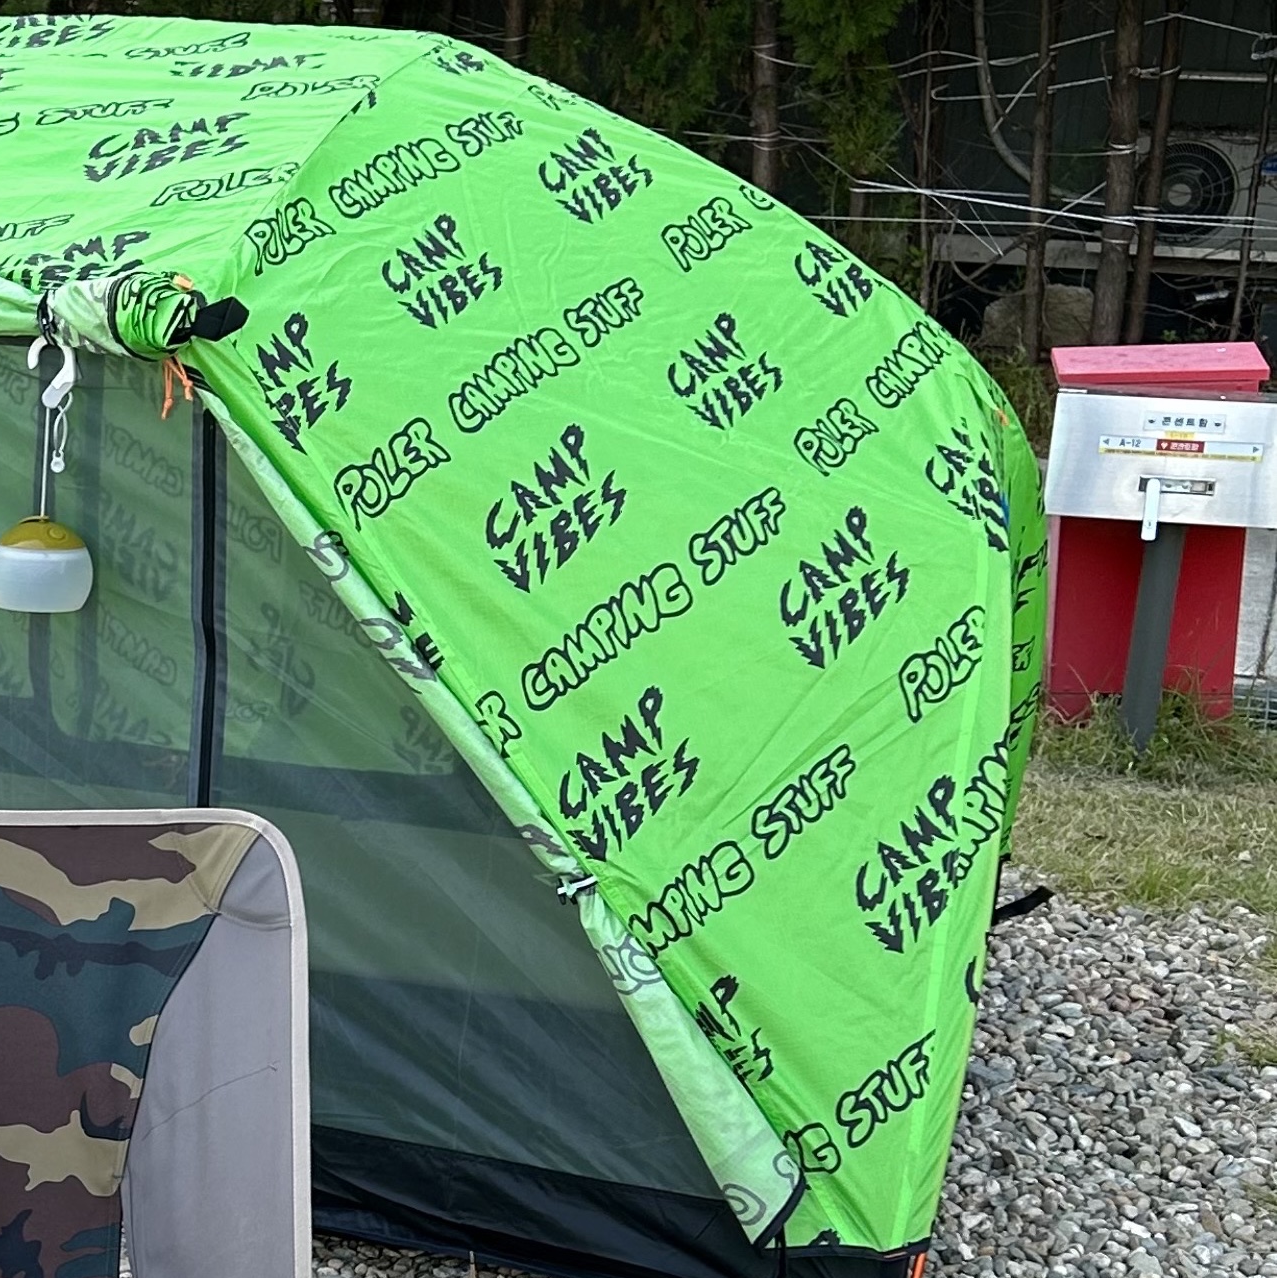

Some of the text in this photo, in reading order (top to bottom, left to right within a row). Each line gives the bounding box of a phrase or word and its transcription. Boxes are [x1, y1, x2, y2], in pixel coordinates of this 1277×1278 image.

[36, 98, 175, 126] STUFF
[88, 112, 251, 160] CAMP
[83, 133, 250, 182] VIBES
[149, 162, 300, 207] POLER
[538, 127, 615, 193] CAMP
[555, 154, 653, 224] VIBES
[244, 198, 337, 275] POLER
[328, 138, 461, 218] CAMPING
[661, 197, 753, 272] POLER
[382, 214, 466, 294] CAMP
[398, 252, 503, 329] VIBES
[667, 313, 746, 399] CAMP
[685, 351, 783, 430] VIBES
[334, 277, 644, 532] POLER CAMPING STUFF
[794, 398, 880, 477] POLER
[486, 423, 592, 550] CAMP
[494, 469, 628, 594] VIBES
[780, 505, 874, 627] CAMP
[523, 562, 694, 711] CAMPING
[689, 486, 787, 587] STUFF
[788, 550, 911, 669] VIBES
[560, 685, 663, 818] CAMP
[567, 737, 700, 862] VIBES
[752, 744, 856, 859] STUFF
[856, 774, 959, 911] CAMP
